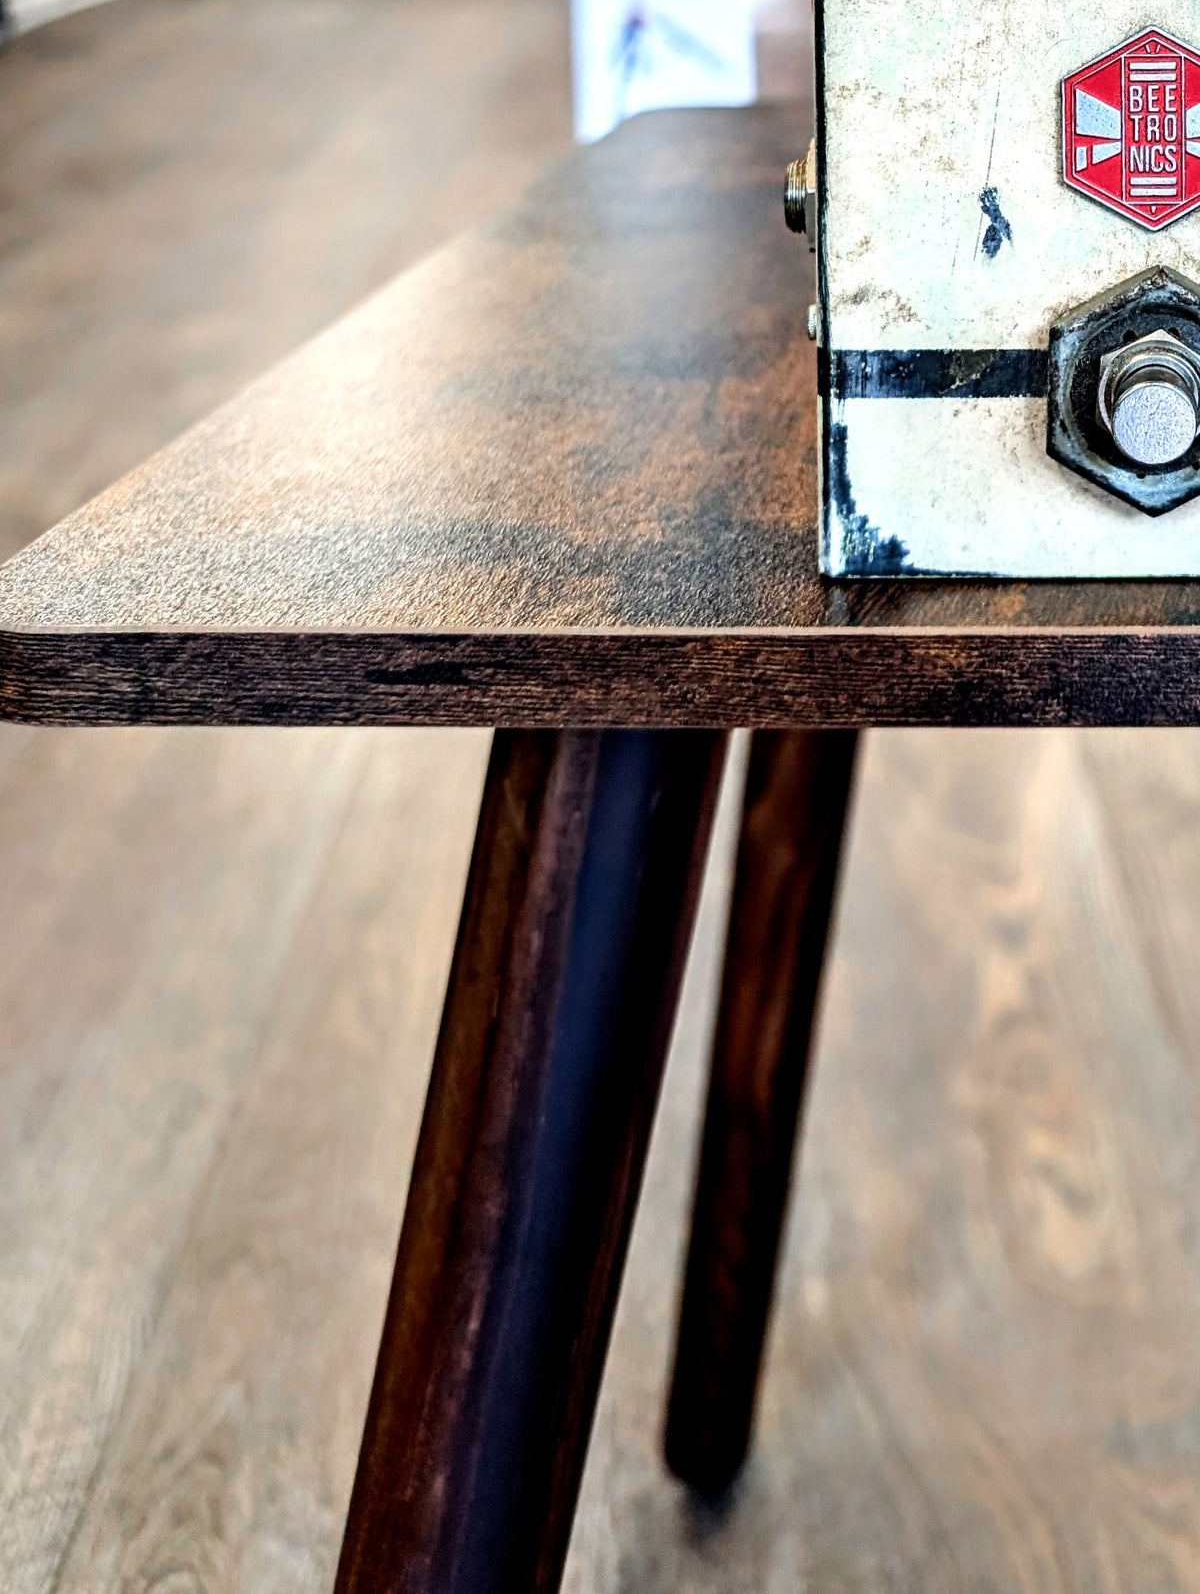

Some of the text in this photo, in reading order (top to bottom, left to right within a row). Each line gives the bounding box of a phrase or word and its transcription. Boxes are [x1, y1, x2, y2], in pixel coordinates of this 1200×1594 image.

[1128, 84, 1178, 112] BEE
[1128, 114, 1178, 142] TRO
[1129, 145, 1178, 173] NICS
